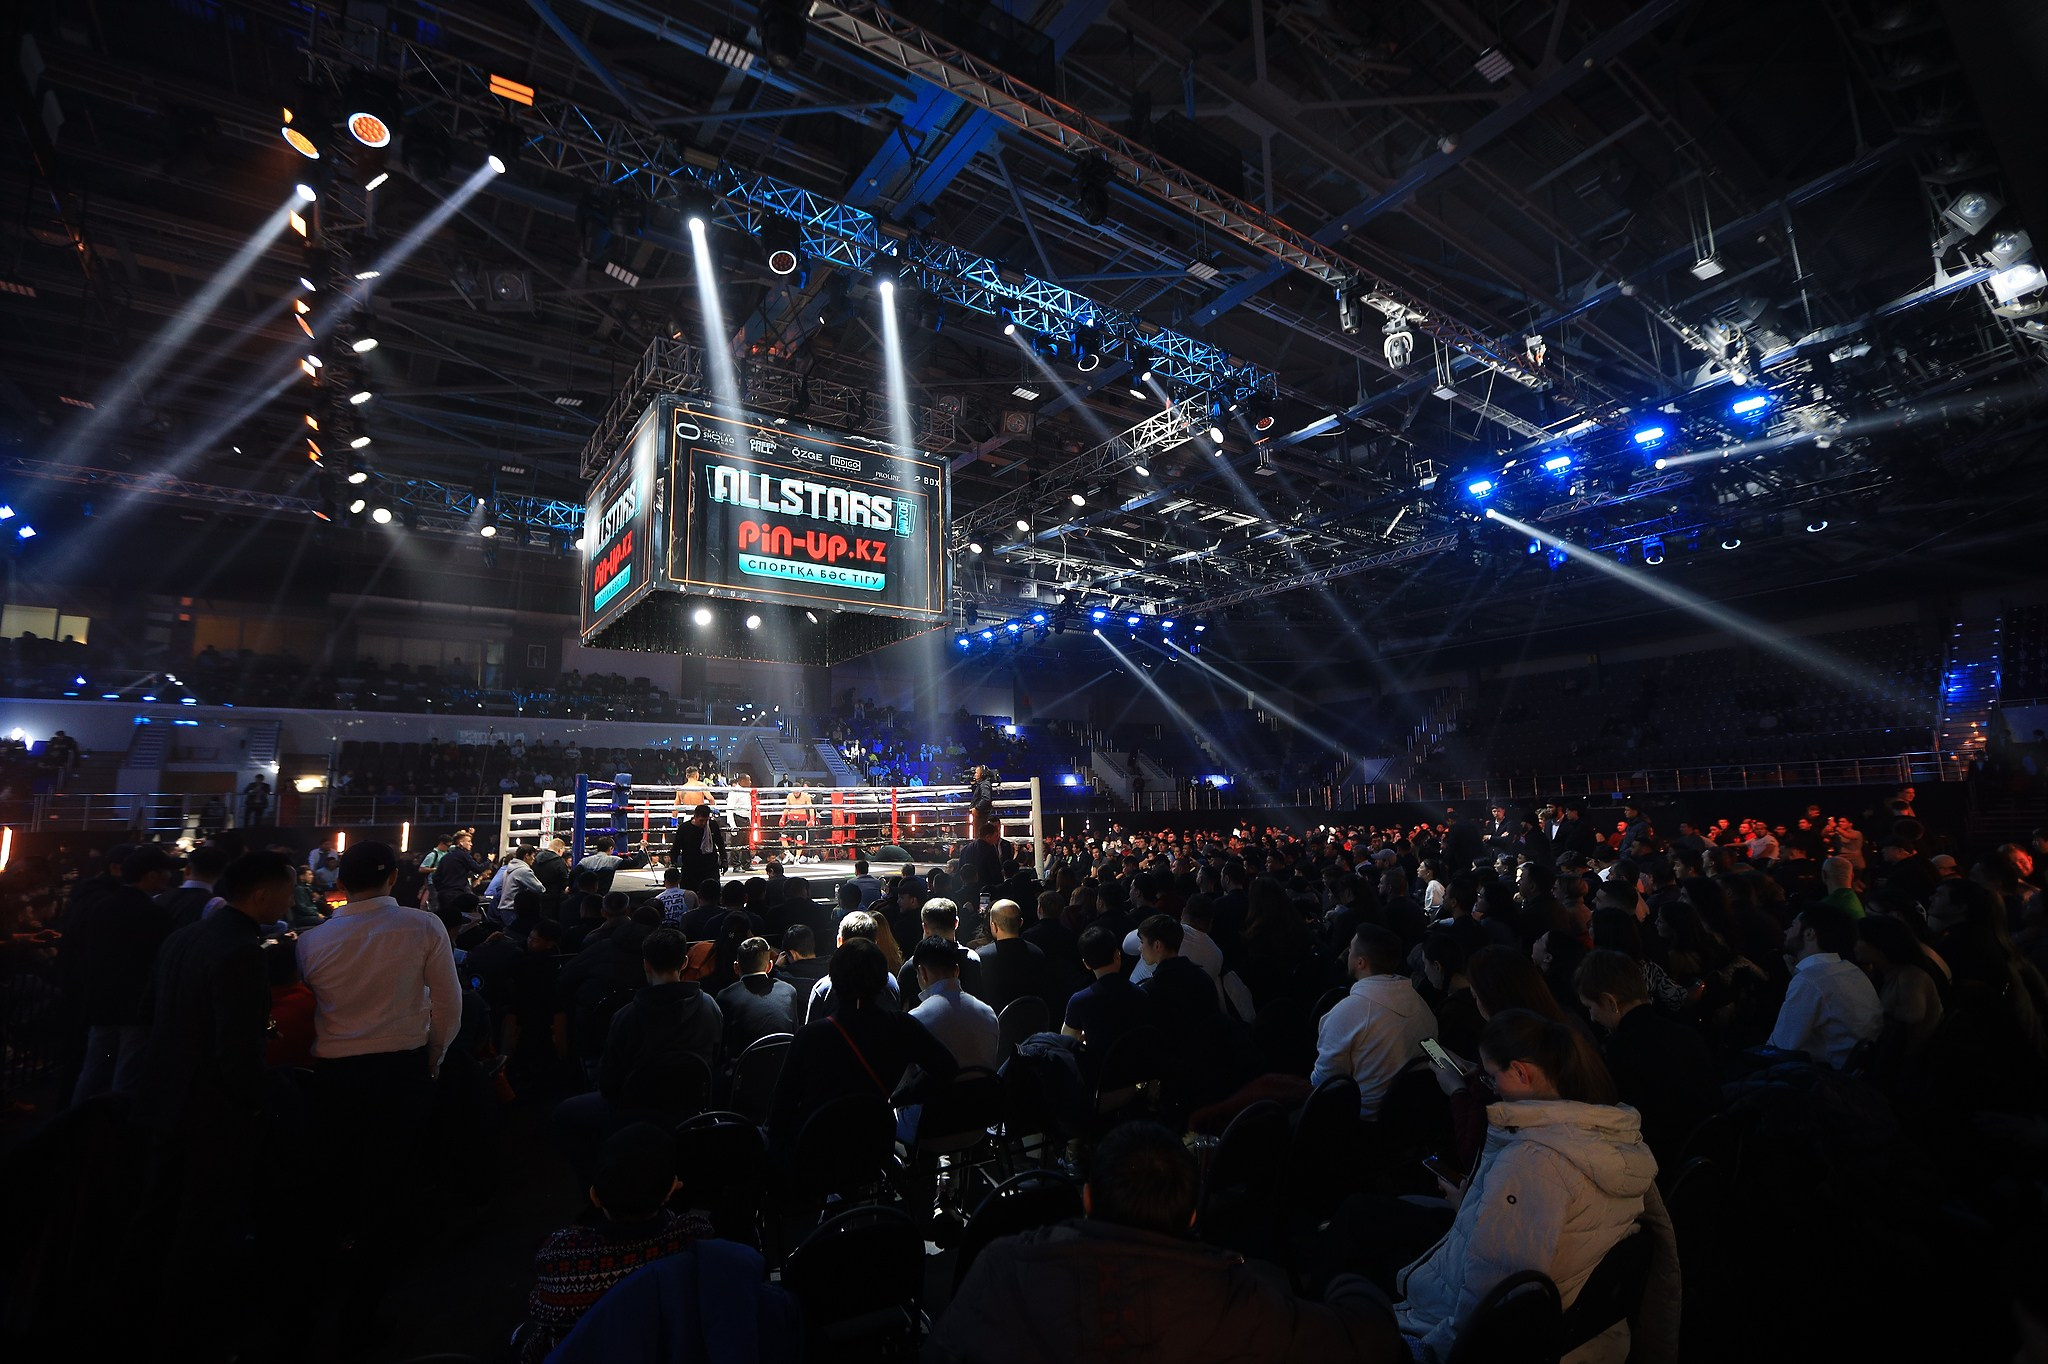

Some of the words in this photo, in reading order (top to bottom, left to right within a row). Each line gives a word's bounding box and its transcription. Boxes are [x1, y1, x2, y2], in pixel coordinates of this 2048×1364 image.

[751, 444, 773, 455] HILL
[832, 456, 860, 469] INDIGO
[714, 465, 893, 531] ALLSTARS
[748, 560, 815, 578] СПОРТҚА
[820, 570, 847, 582] БӘС
[852, 574, 879, 586] ТІГУ
